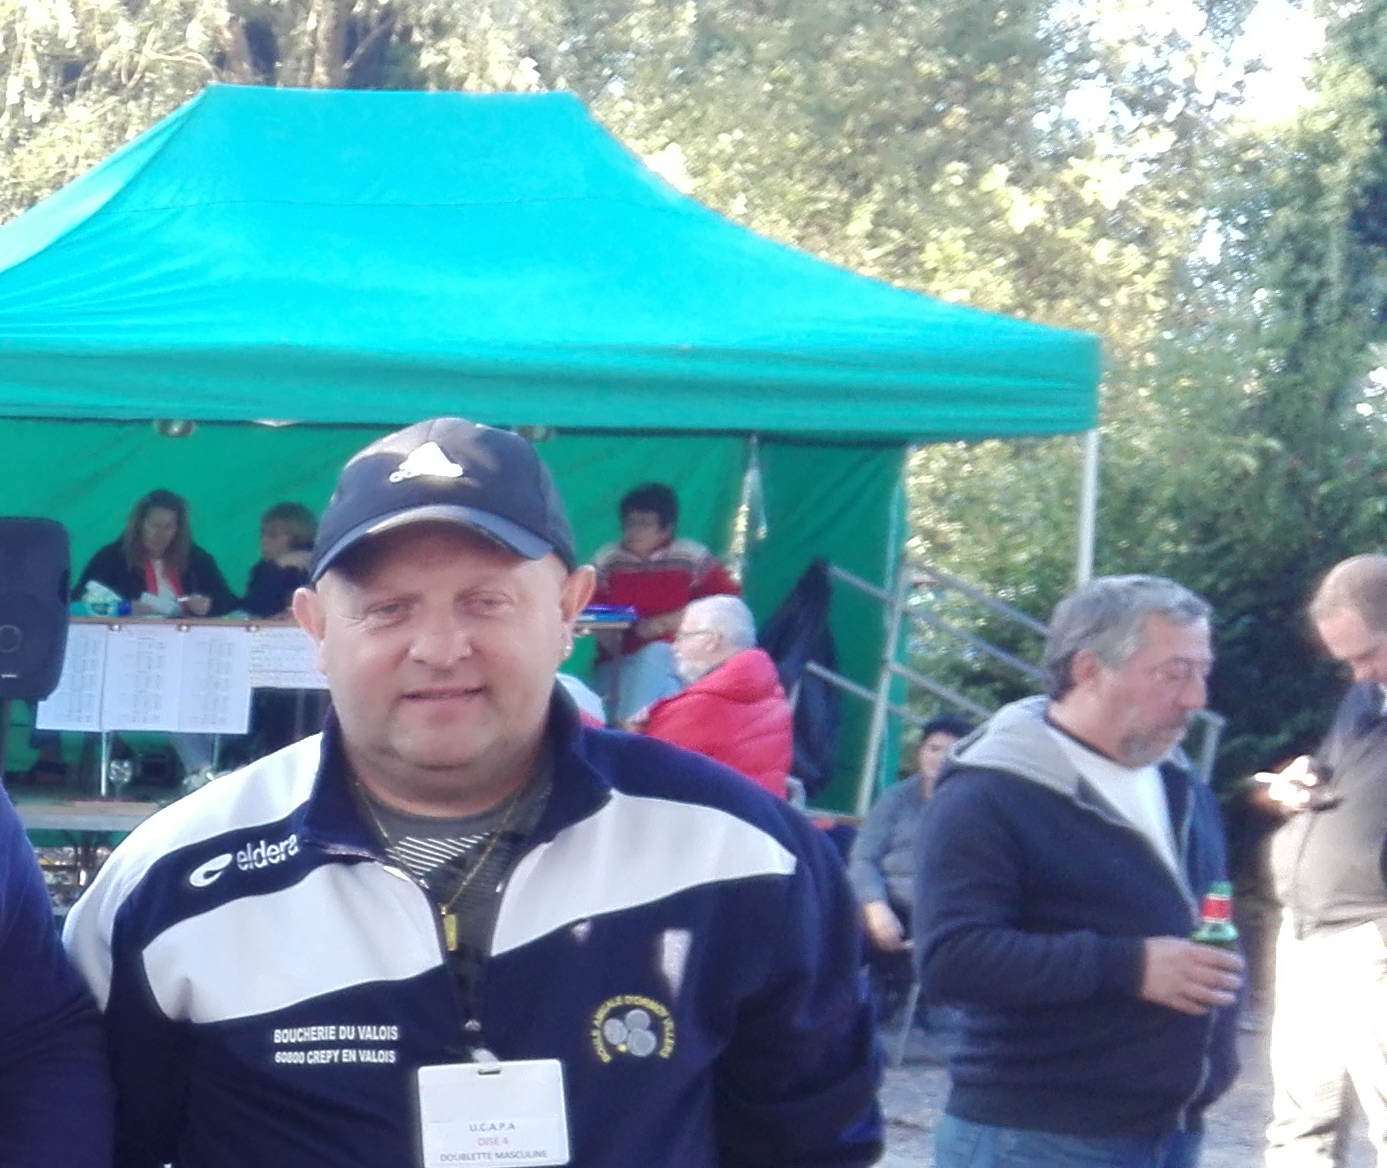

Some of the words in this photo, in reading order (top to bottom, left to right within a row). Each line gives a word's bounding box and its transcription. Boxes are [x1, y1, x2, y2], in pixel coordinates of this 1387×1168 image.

[236, 834, 299, 871] eldera
[273, 1026, 336, 1043] BOUCHERIE
[339, 1026, 355, 1040] DU
[357, 1025, 398, 1041] VALOIS
[306, 1051, 339, 1064] CREPY
[341, 1049, 356, 1062] EN
[358, 1049, 396, 1064] VALOIS
